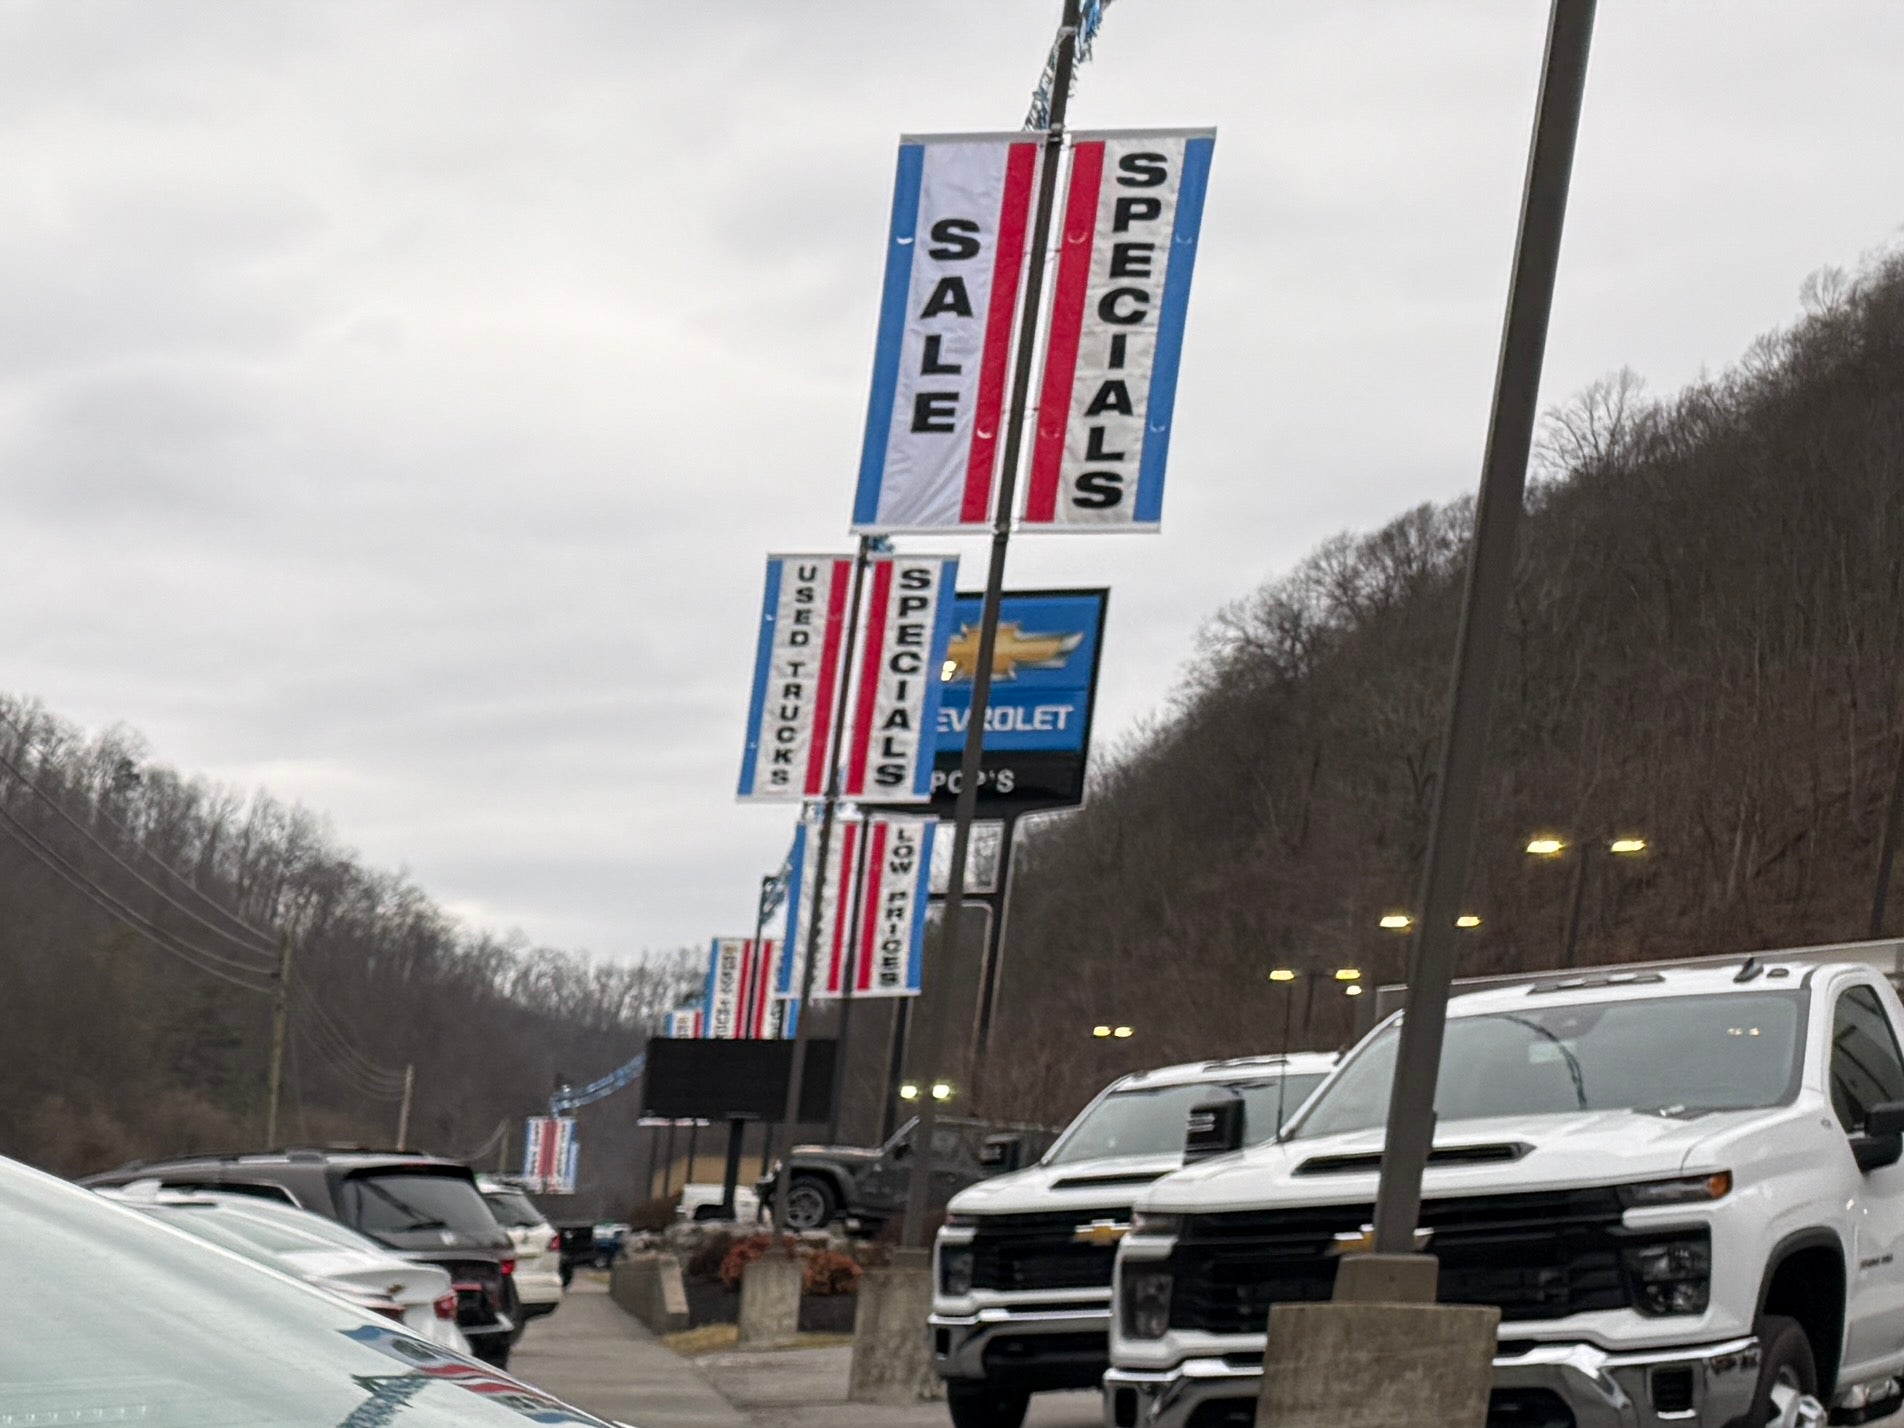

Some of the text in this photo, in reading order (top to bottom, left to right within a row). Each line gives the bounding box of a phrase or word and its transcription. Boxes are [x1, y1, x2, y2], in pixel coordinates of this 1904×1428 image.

[911, 218, 981, 434] SALE
[1072, 152, 1169, 509] SPECIALS
[771, 566, 817, 786] USED TRUCKS
[874, 568, 932, 787] SPECIALS
[879, 828, 914, 987] LOW PRICES
